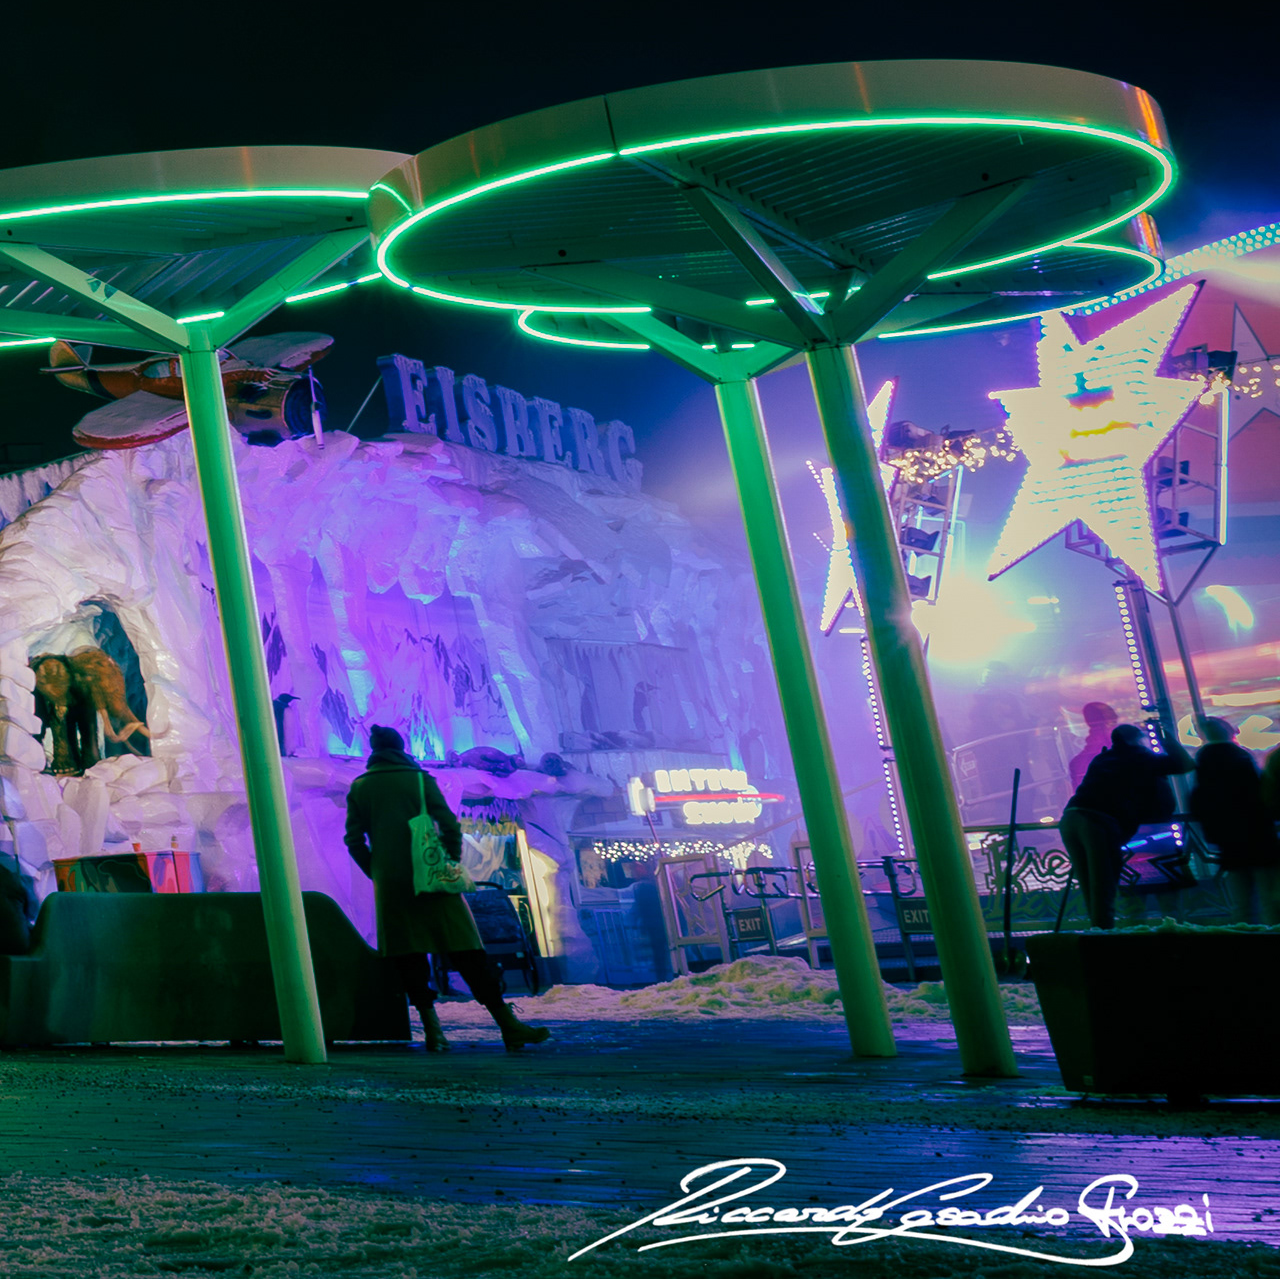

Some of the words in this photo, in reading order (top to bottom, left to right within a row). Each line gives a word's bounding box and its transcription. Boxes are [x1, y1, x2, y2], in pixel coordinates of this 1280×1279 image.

[378, 353, 643, 486] EISBERG
[903, 909, 929, 923] EXIT
[738, 917, 761, 932] EXIT
